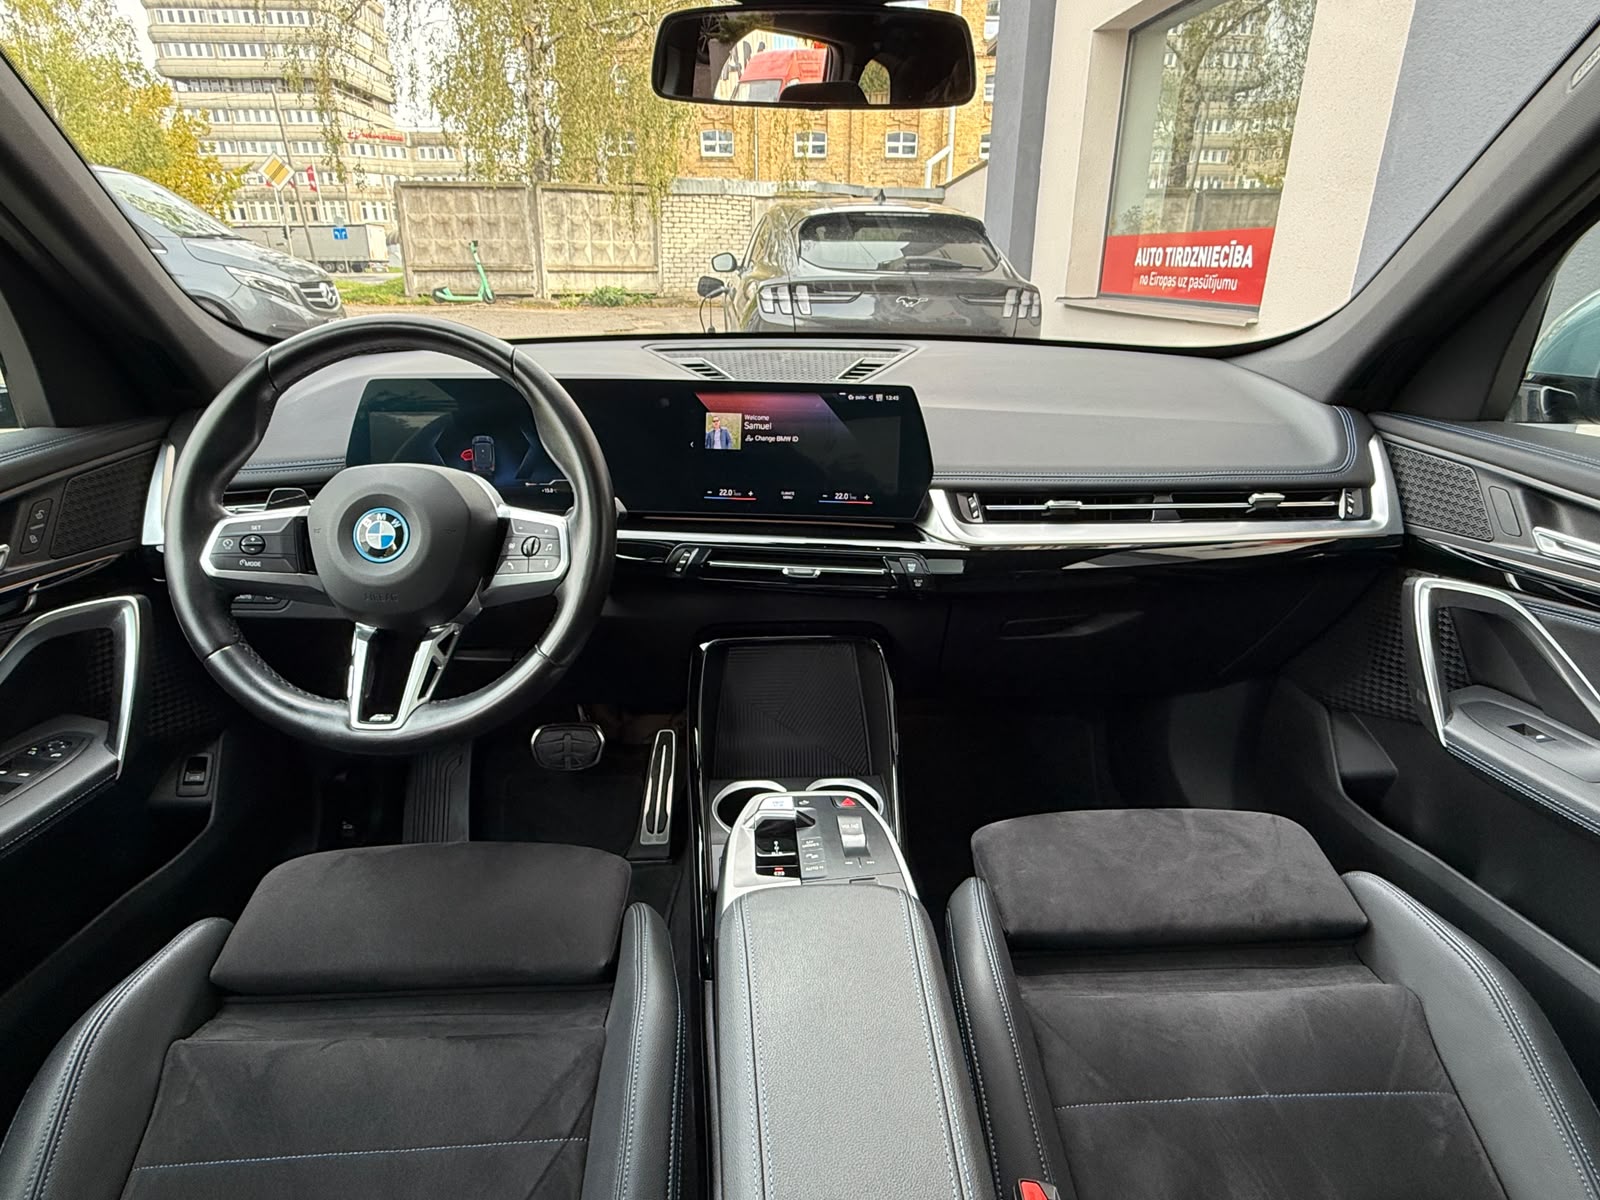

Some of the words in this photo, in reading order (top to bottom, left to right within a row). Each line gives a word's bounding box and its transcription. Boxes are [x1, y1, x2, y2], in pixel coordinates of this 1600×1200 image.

[1134, 247, 1163, 267] AUTO
[1165, 240, 1253, 268] TIRDZNIECĪBA
[1139, 275, 1149, 285] no
[1149, 271, 1177, 290] Eiropas
[1177, 276, 1188, 288] uz
[1187, 273, 1238, 294] pasūtījumu
[744, 422, 772, 430] Samuel
[754, 435, 776, 443] Change
[719, 488, 733, 497] 22.0
[834, 492, 848, 500] 22.0
[361, 513, 402, 528] BMW
